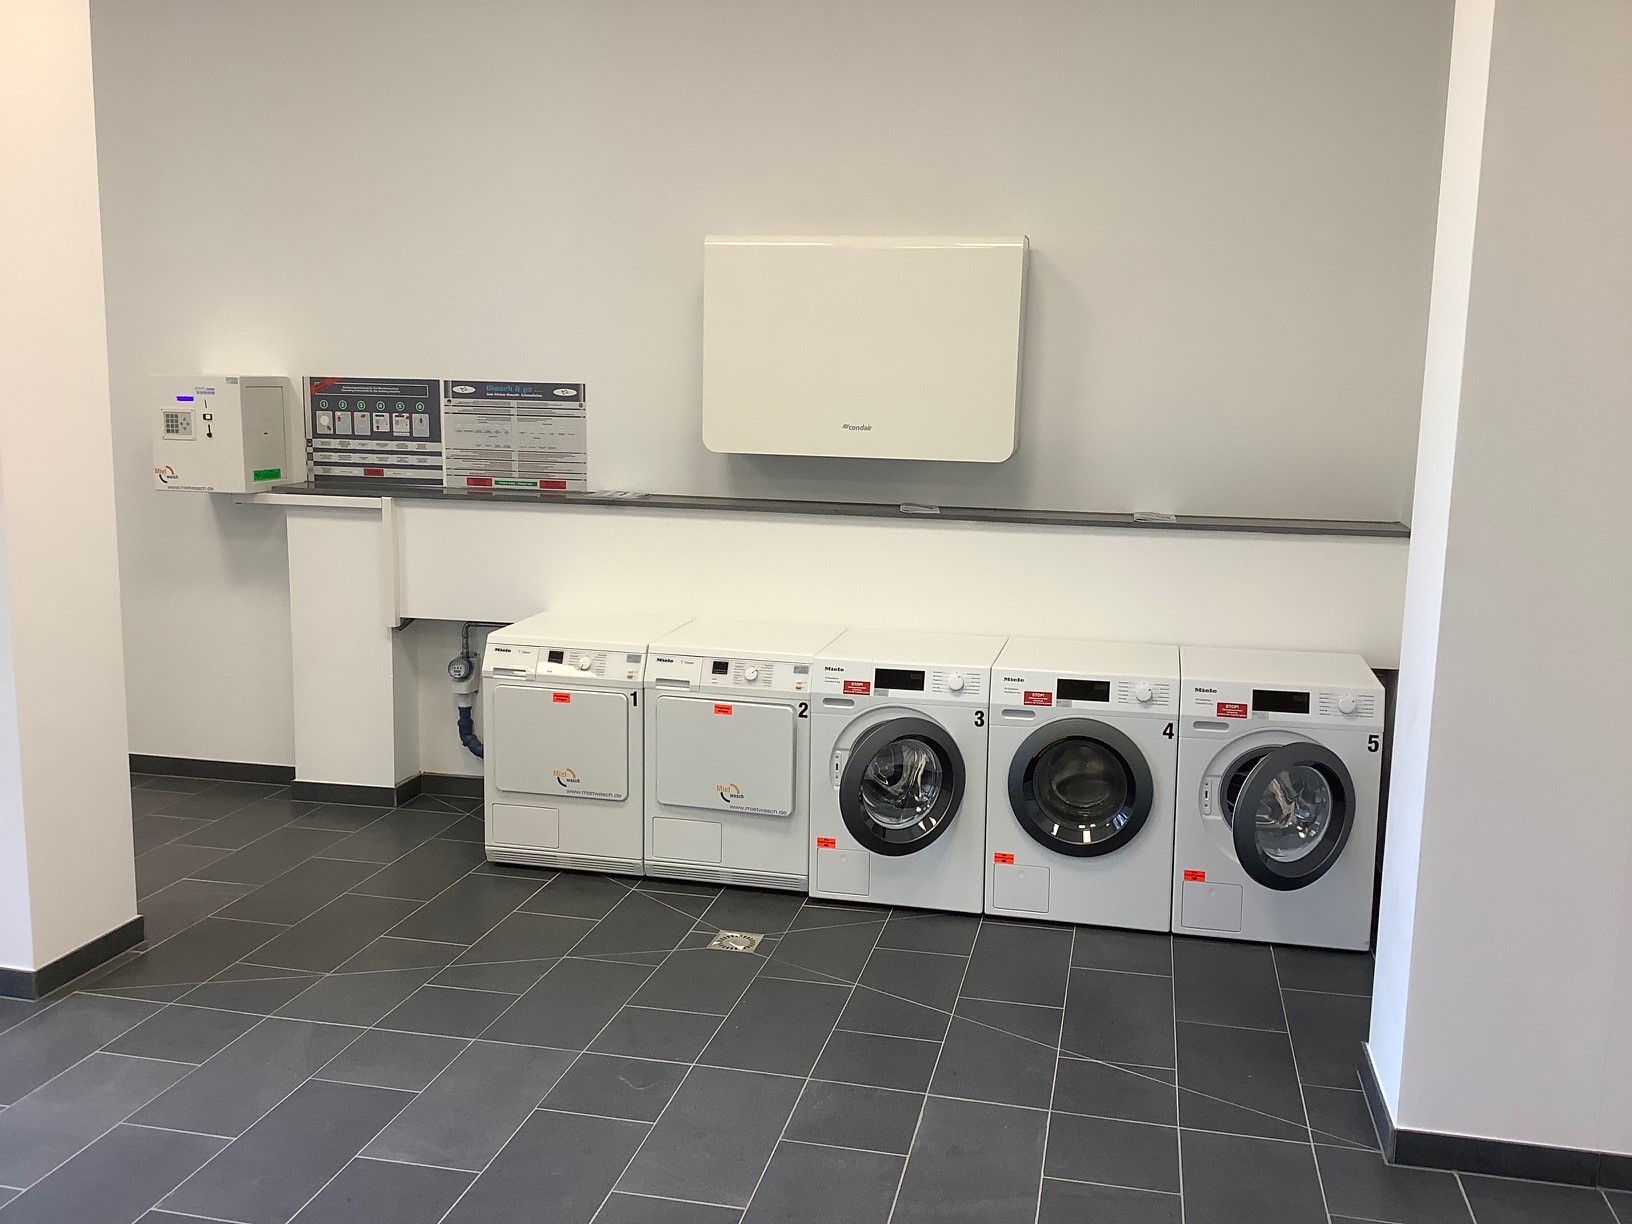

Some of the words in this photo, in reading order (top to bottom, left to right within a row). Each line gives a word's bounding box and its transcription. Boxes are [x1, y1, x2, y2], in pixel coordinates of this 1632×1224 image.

[486, 384, 513, 393] Wasch
[629, 690, 638, 707] 1
[798, 702, 809, 719] 2
[974, 710, 985, 727] 3
[1162, 722, 1174, 740] 4
[1367, 734, 1380, 752] 5
[565, 789, 622, 798] www.mietwasch.de
[729, 805, 787, 815] www.mietwasch.de
